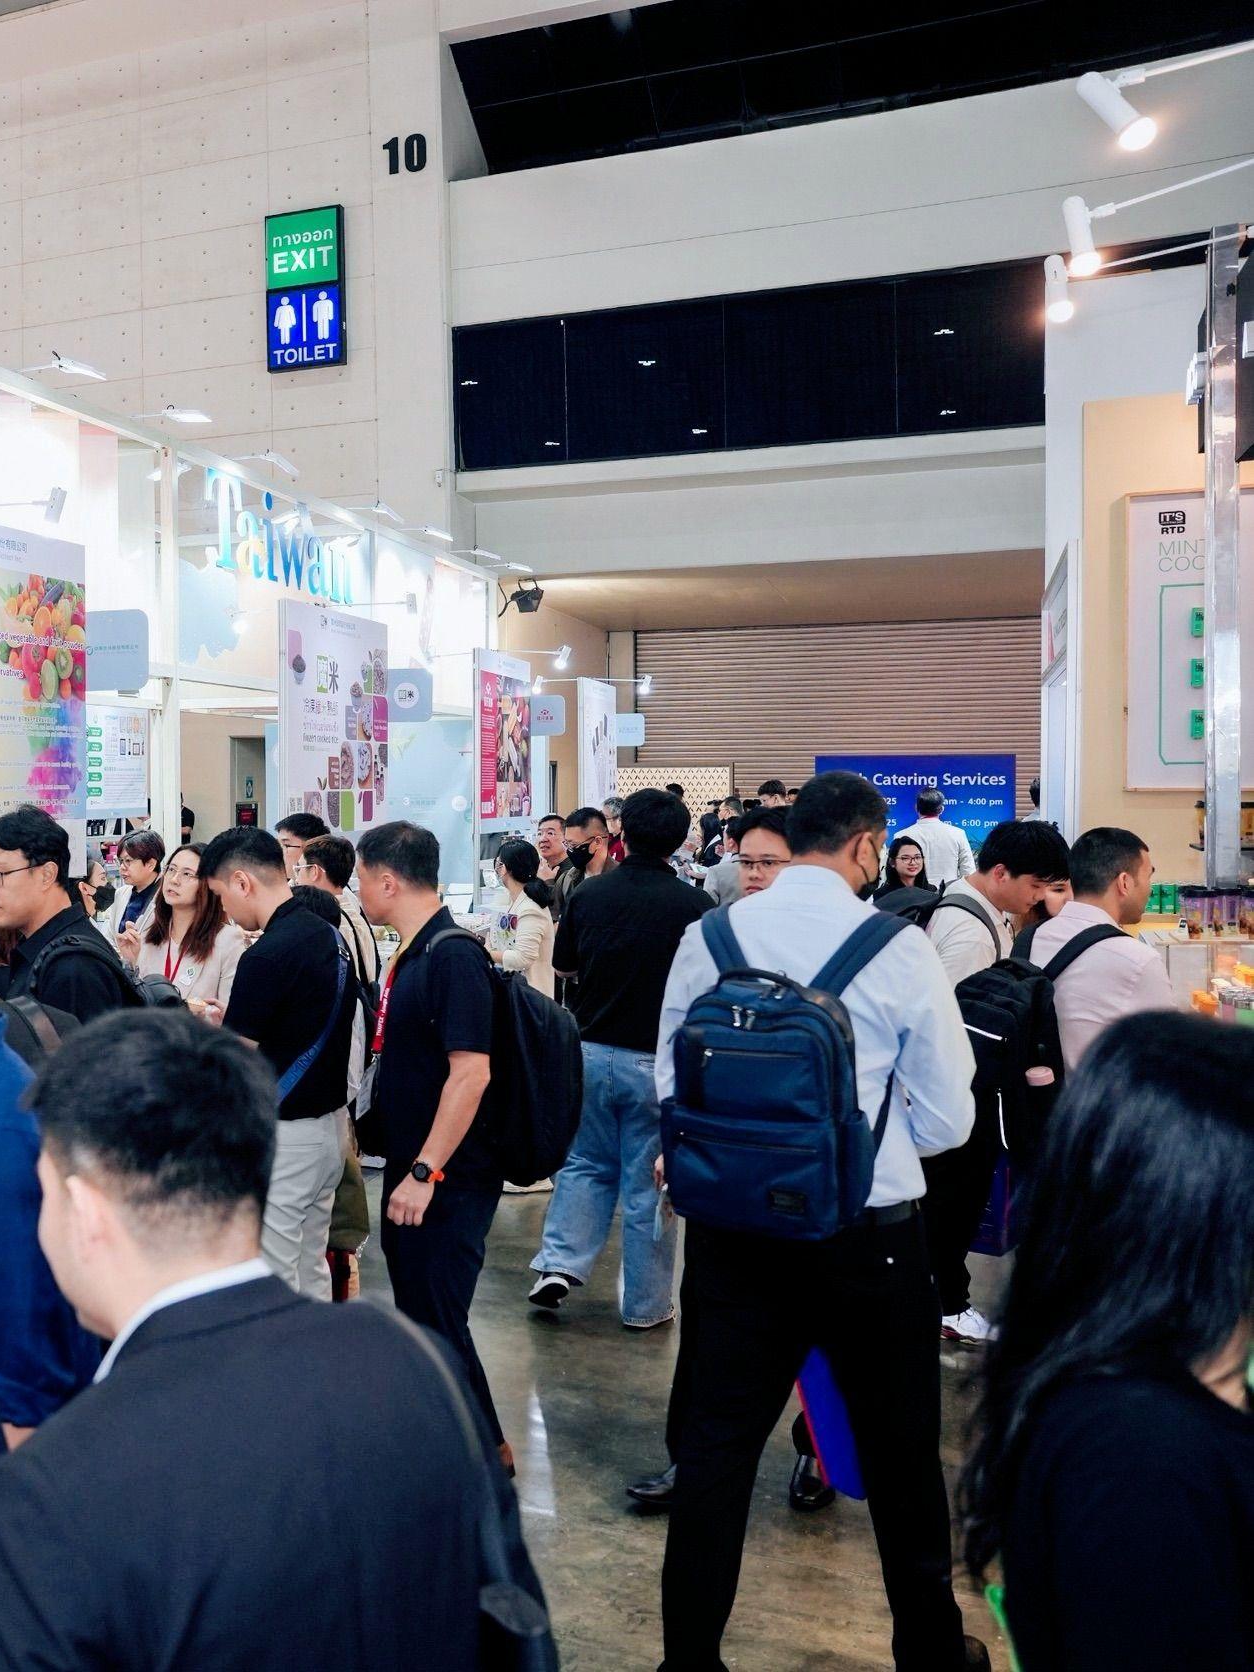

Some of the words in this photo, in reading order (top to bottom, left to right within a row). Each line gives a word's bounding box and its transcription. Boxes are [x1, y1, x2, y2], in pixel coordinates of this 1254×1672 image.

[383, 134, 427, 174] 10
[273, 229, 333, 247] ทางออก
[273, 246, 333, 274] EXIT
[273, 343, 337, 365] TOILET
[1161, 512, 1183, 522] IT'S
[205, 466, 354, 605] Taiwan
[1161, 526, 1185, 535] RTD
[873, 774, 937, 788] Catering
[943, 773, 1006, 786] Services
[989, 799, 1003, 807] pm
[961, 819, 980, 827] 6:00
[984, 821, 998, 829] pm
